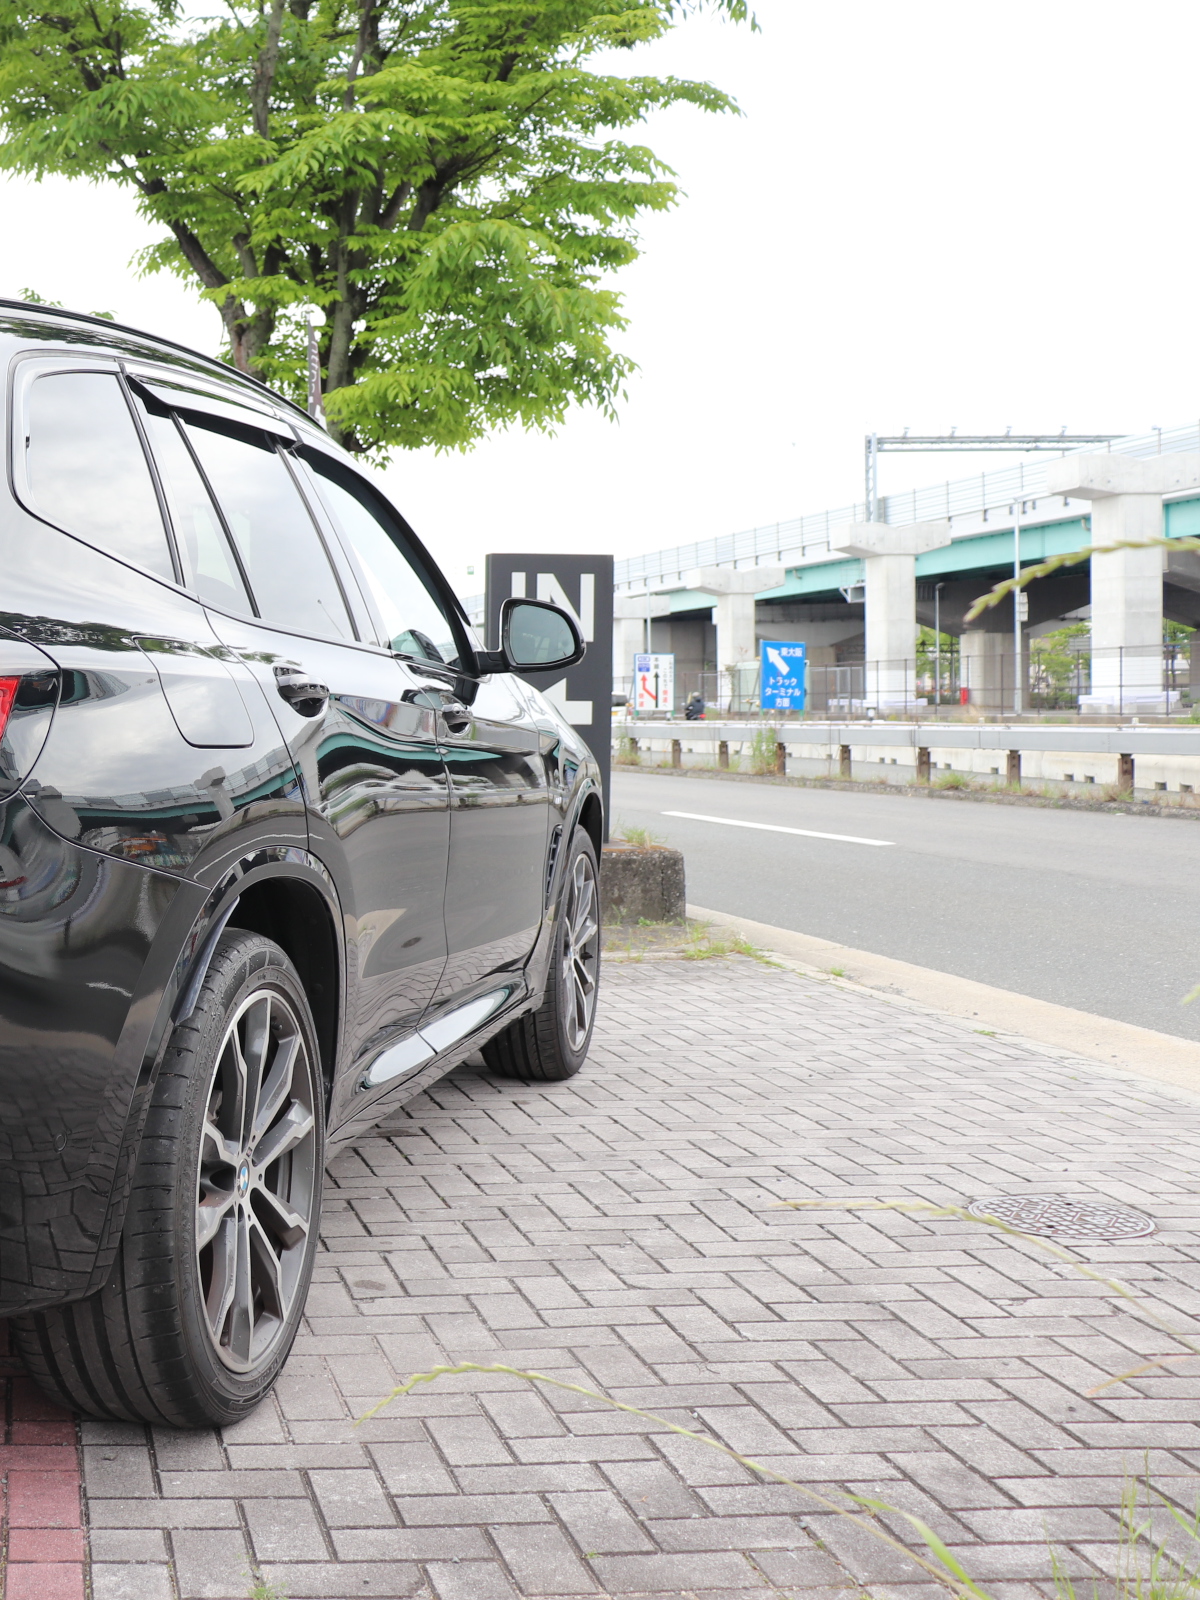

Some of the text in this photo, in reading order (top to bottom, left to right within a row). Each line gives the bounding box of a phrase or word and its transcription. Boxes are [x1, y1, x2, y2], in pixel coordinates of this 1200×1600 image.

[780, 647, 803, 657] 東大阪
[769, 676, 798, 686] トラック
[765, 687, 801, 697] ターミナル
